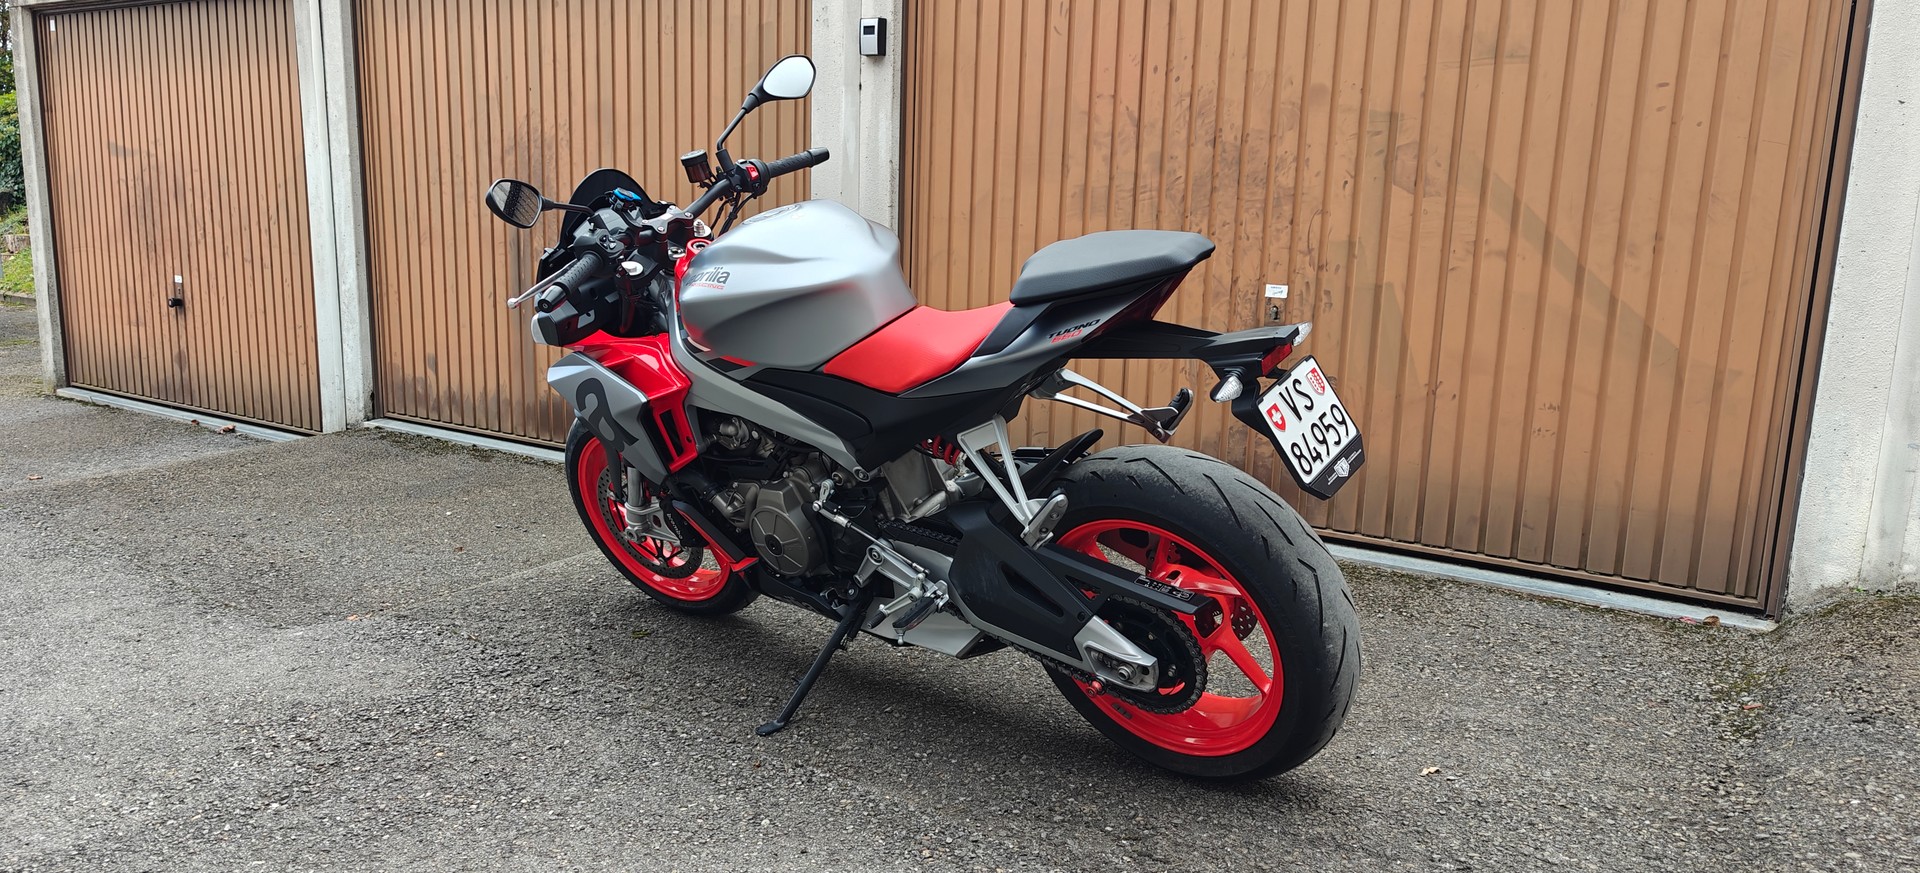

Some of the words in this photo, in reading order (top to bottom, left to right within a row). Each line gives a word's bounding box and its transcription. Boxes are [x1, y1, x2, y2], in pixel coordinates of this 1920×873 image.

[1049, 319, 1101, 339] TUONO
[1279, 378, 1314, 421] VS
[1290, 403, 1349, 475] 84959
